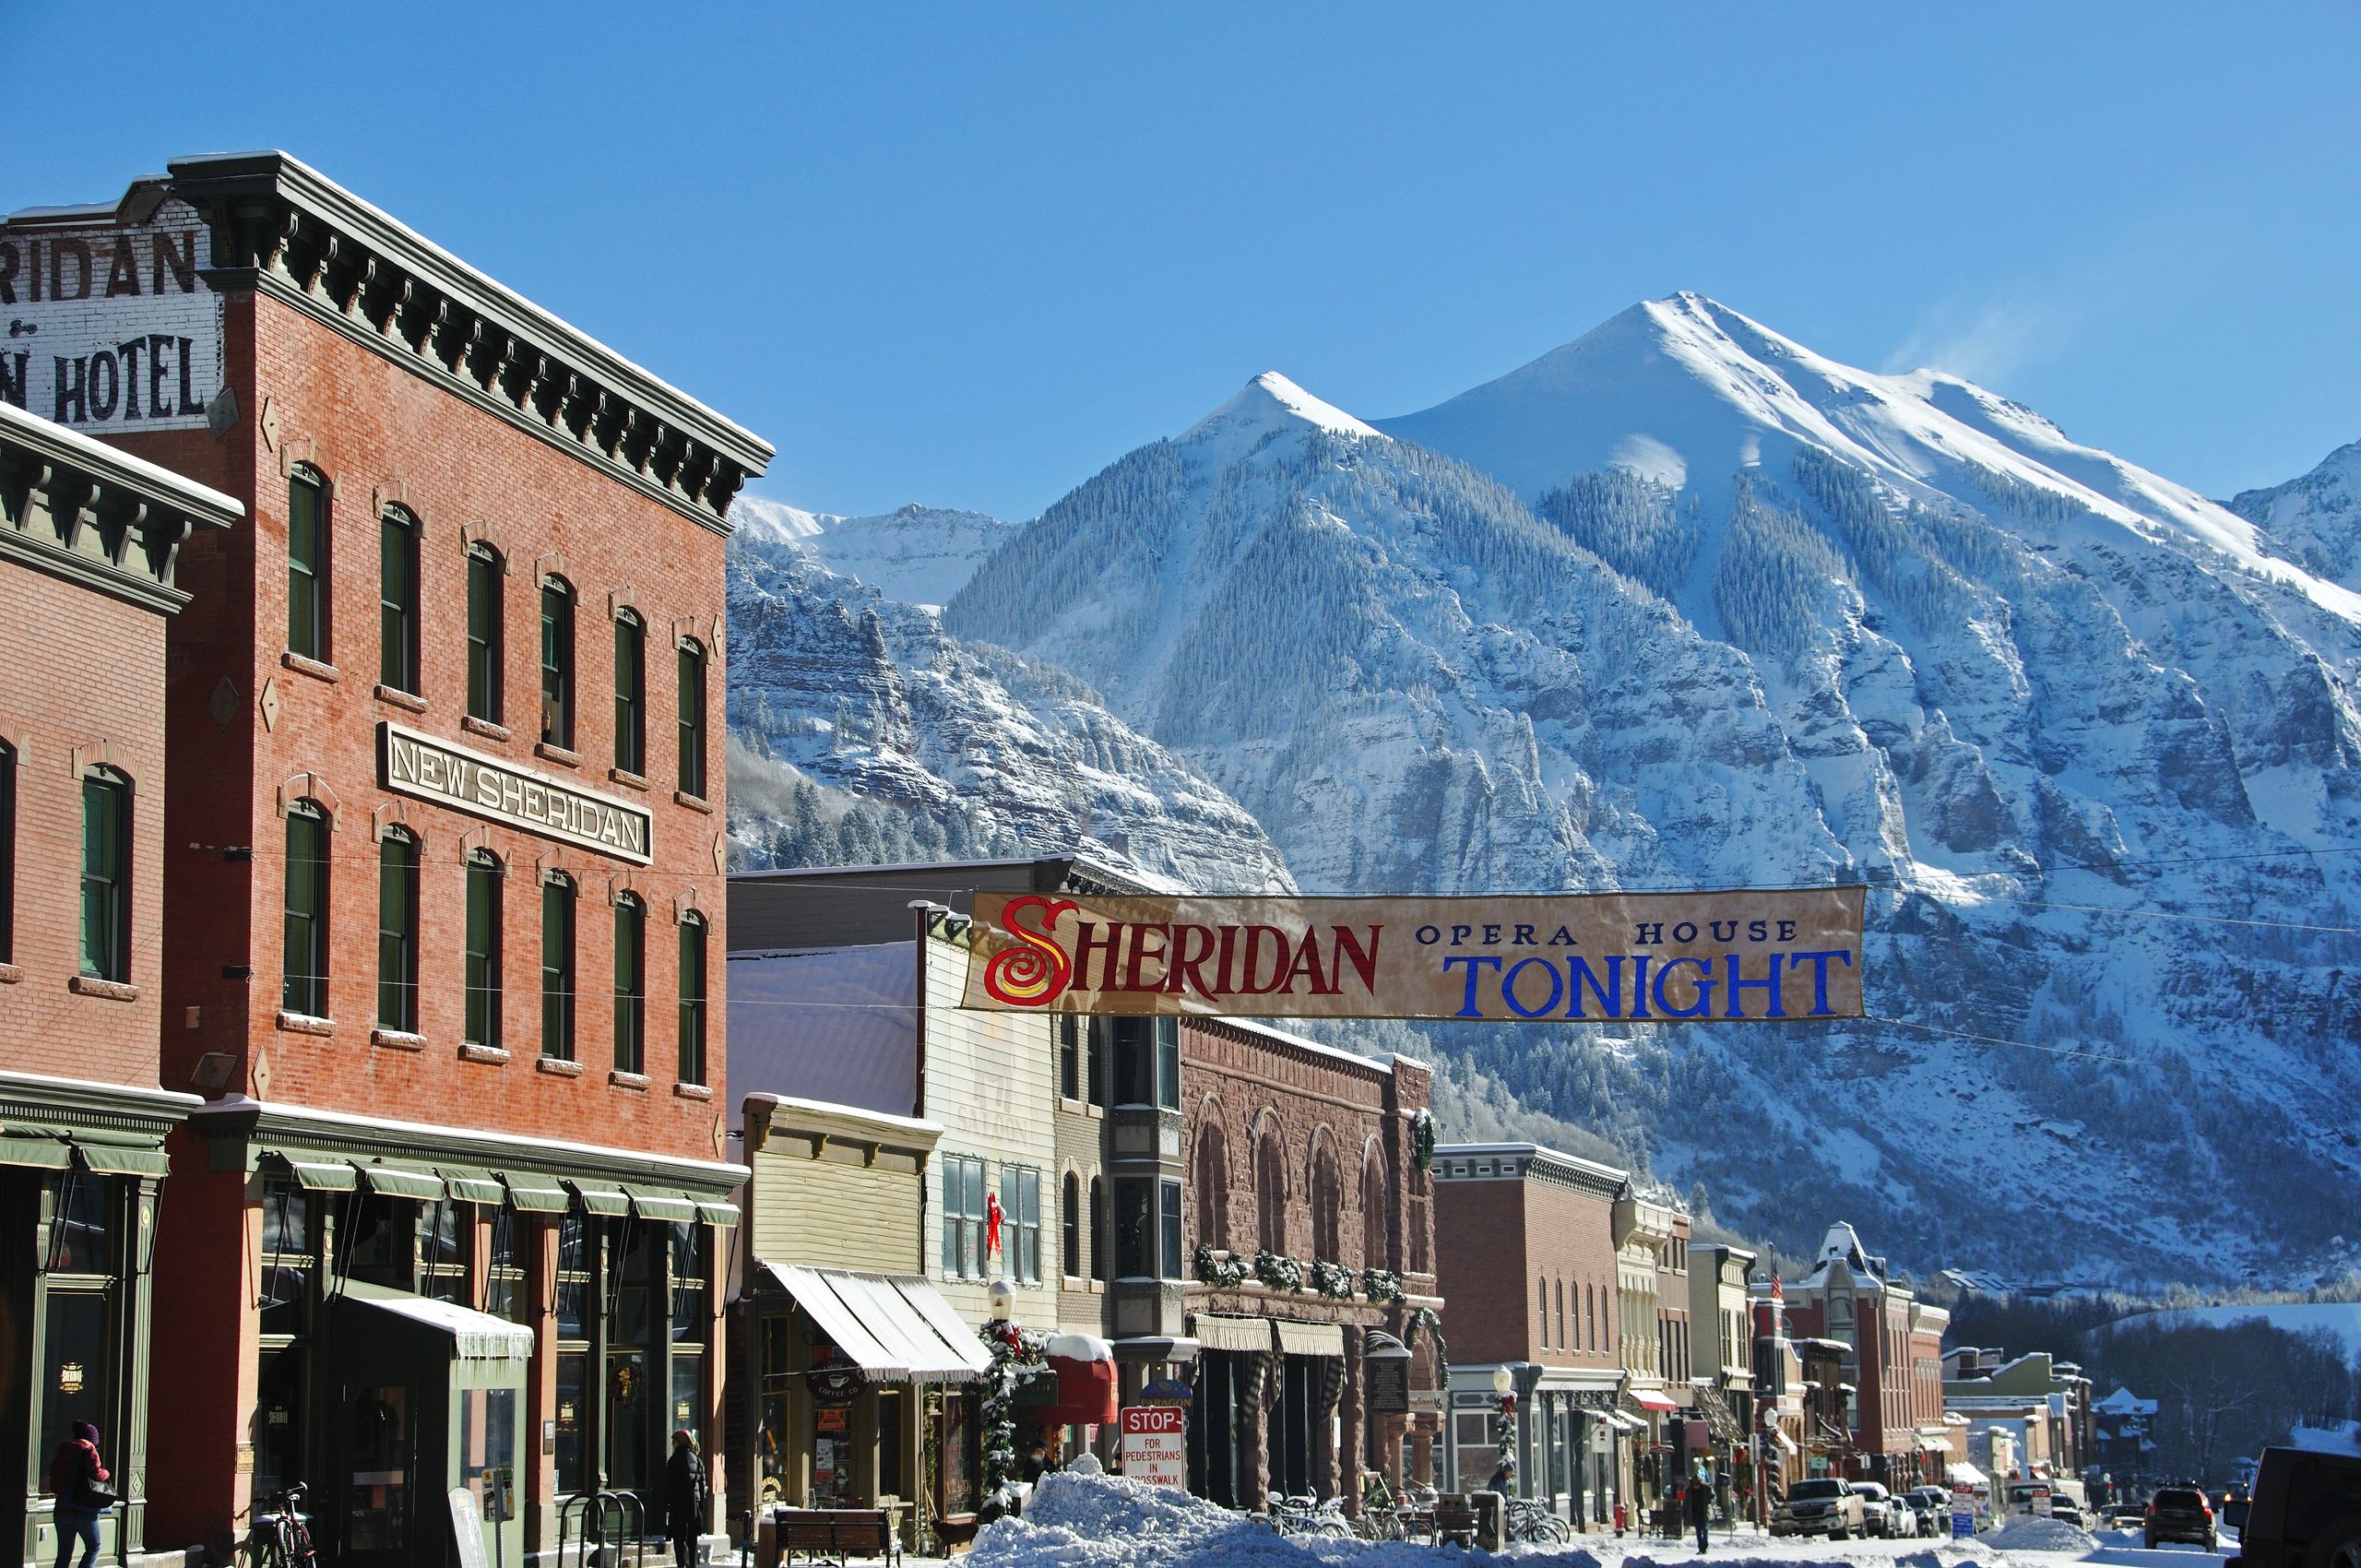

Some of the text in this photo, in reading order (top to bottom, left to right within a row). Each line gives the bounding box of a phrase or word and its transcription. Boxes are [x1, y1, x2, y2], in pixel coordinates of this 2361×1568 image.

[53, 334, 206, 422] HOTEL
[392, 737, 468, 799] NEW
[984, 895, 1798, 1007] SHERIDAN OPERA HOUSE
[1444, 950, 1852, 1019] TONIGHT
[818, 1386, 846, 1397] COFFEE
[1140, 1398, 1192, 1407] PARAGON
[1130, 1412, 1175, 1431] STOP
[1145, 1438, 1161, 1449] FOR
[1125, 1451, 1180, 1461] PEDESTRIANS
[1149, 1463, 1157, 1473] IN
[1954, 1485, 1971, 1493] STOP
